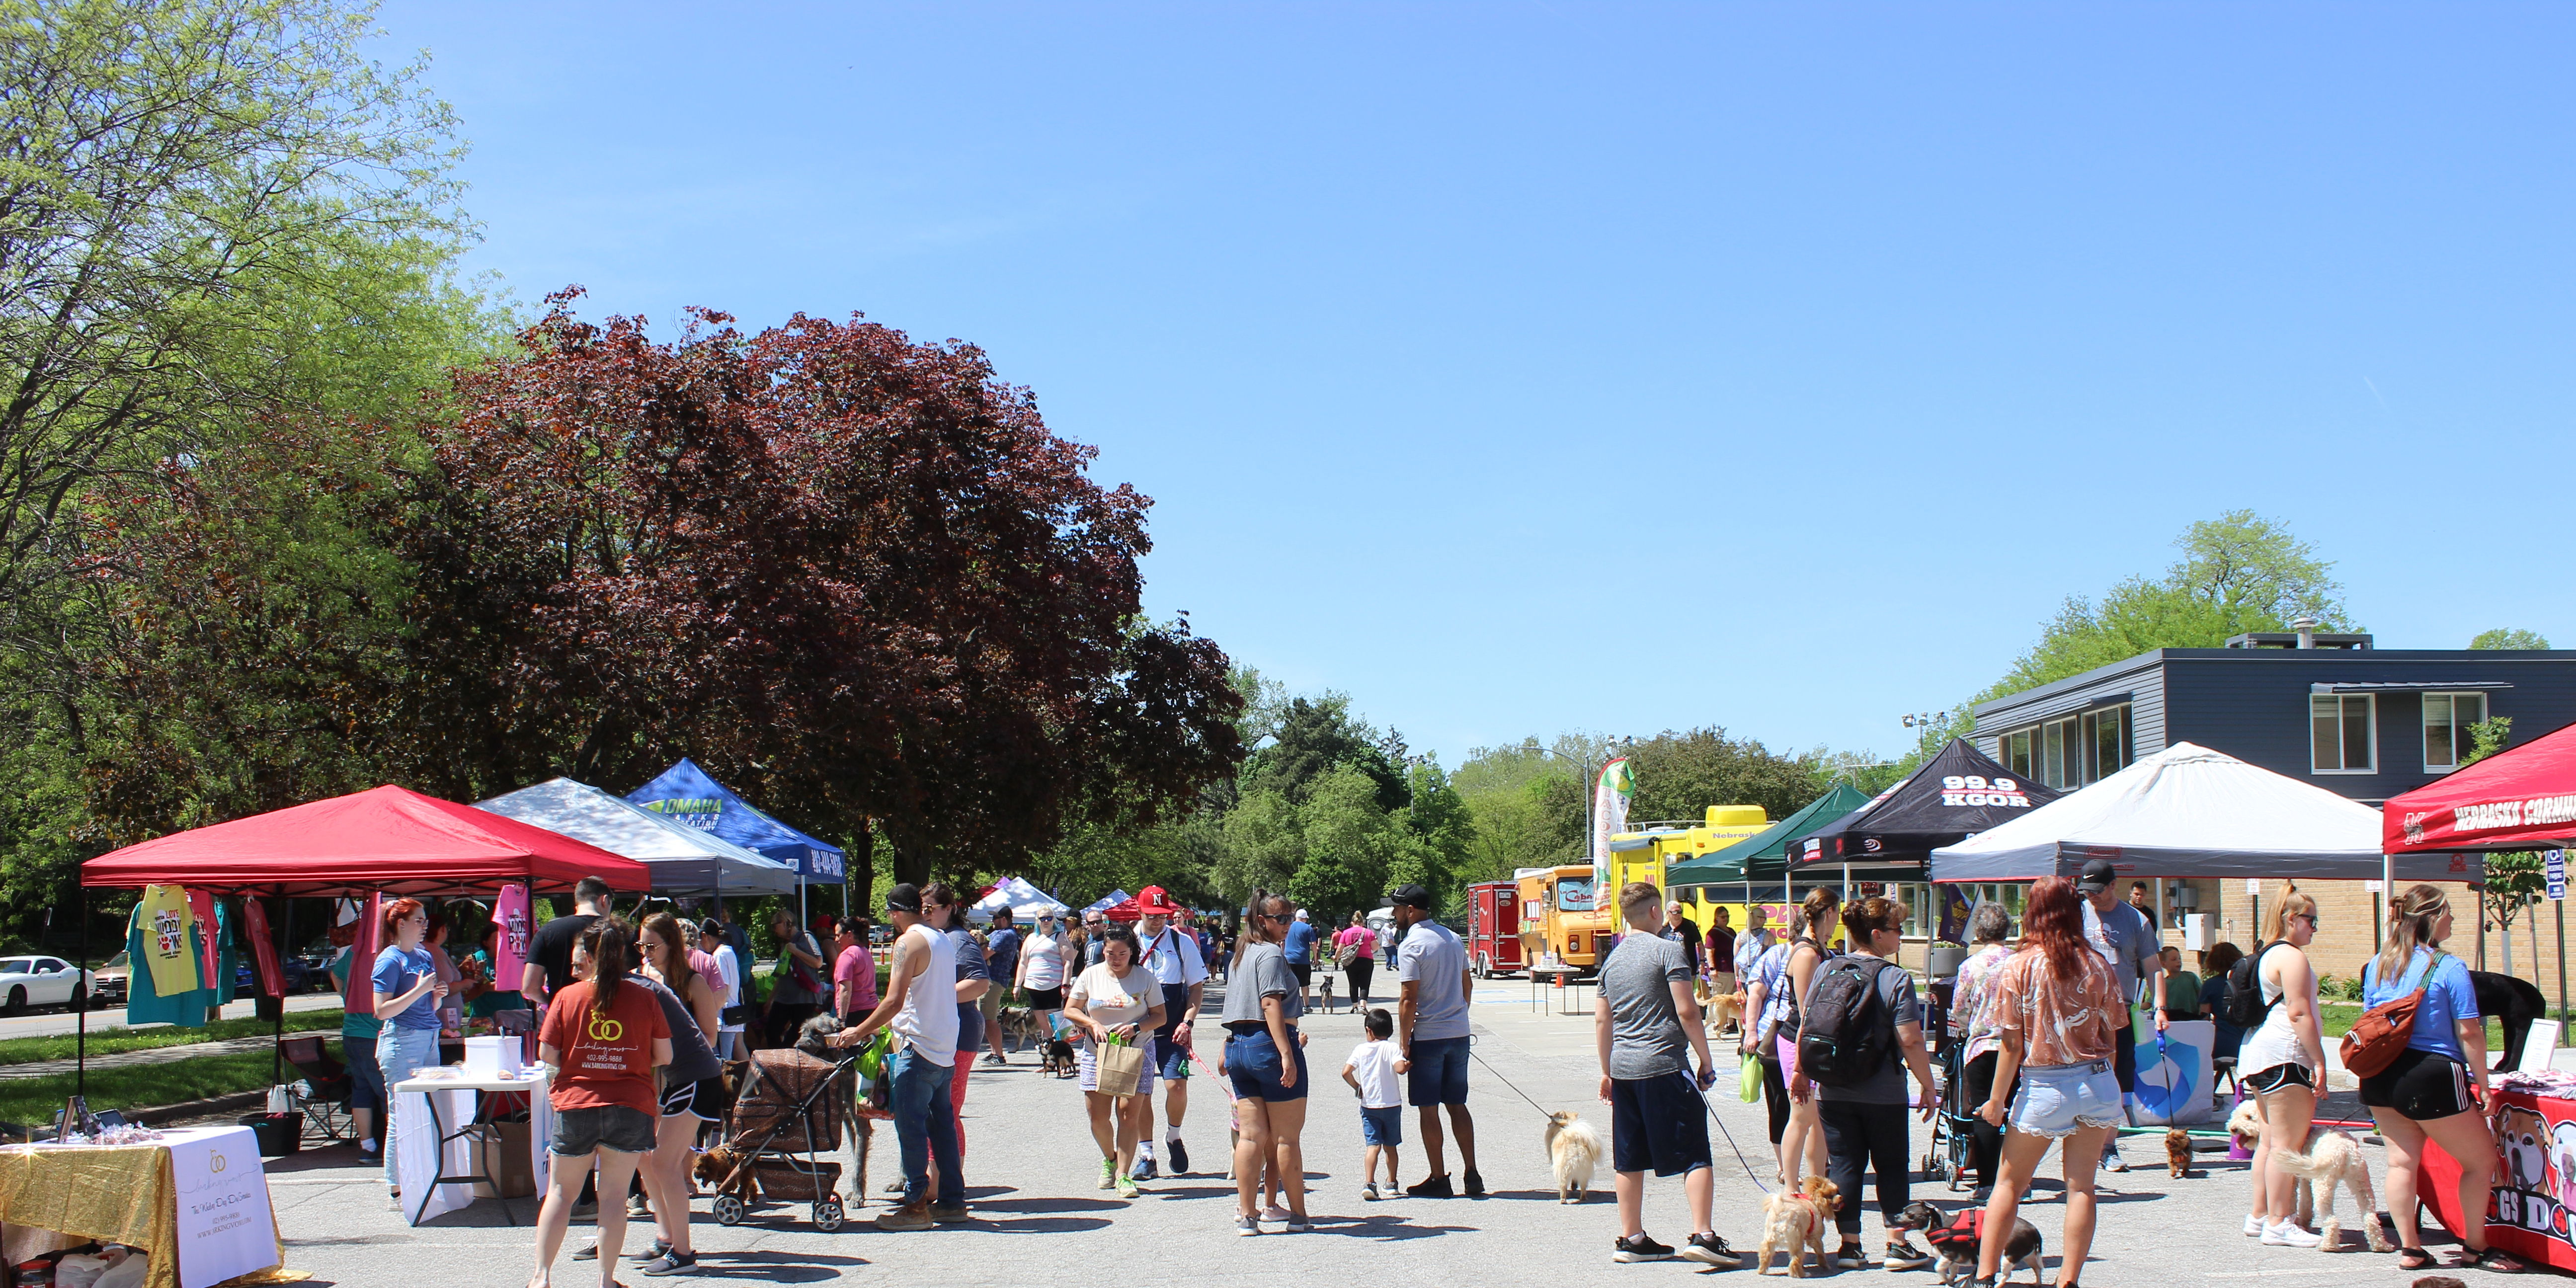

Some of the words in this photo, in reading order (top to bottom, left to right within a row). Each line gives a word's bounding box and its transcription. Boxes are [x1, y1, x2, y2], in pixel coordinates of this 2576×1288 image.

[1942, 776, 2017, 791] 99.9
[665, 799, 722, 813] OMAHA
[1942, 794, 2031, 807] KGOR
[1599, 787, 1613, 842] TACOS
[2453, 801, 2523, 832] NEBRASKA
[1153, 894, 1162, 905] N
[165, 909, 179, 919] LOVE
[586, 1054, 622, 1062] 402-995-9888
[191, 1205, 200, 1215] The
